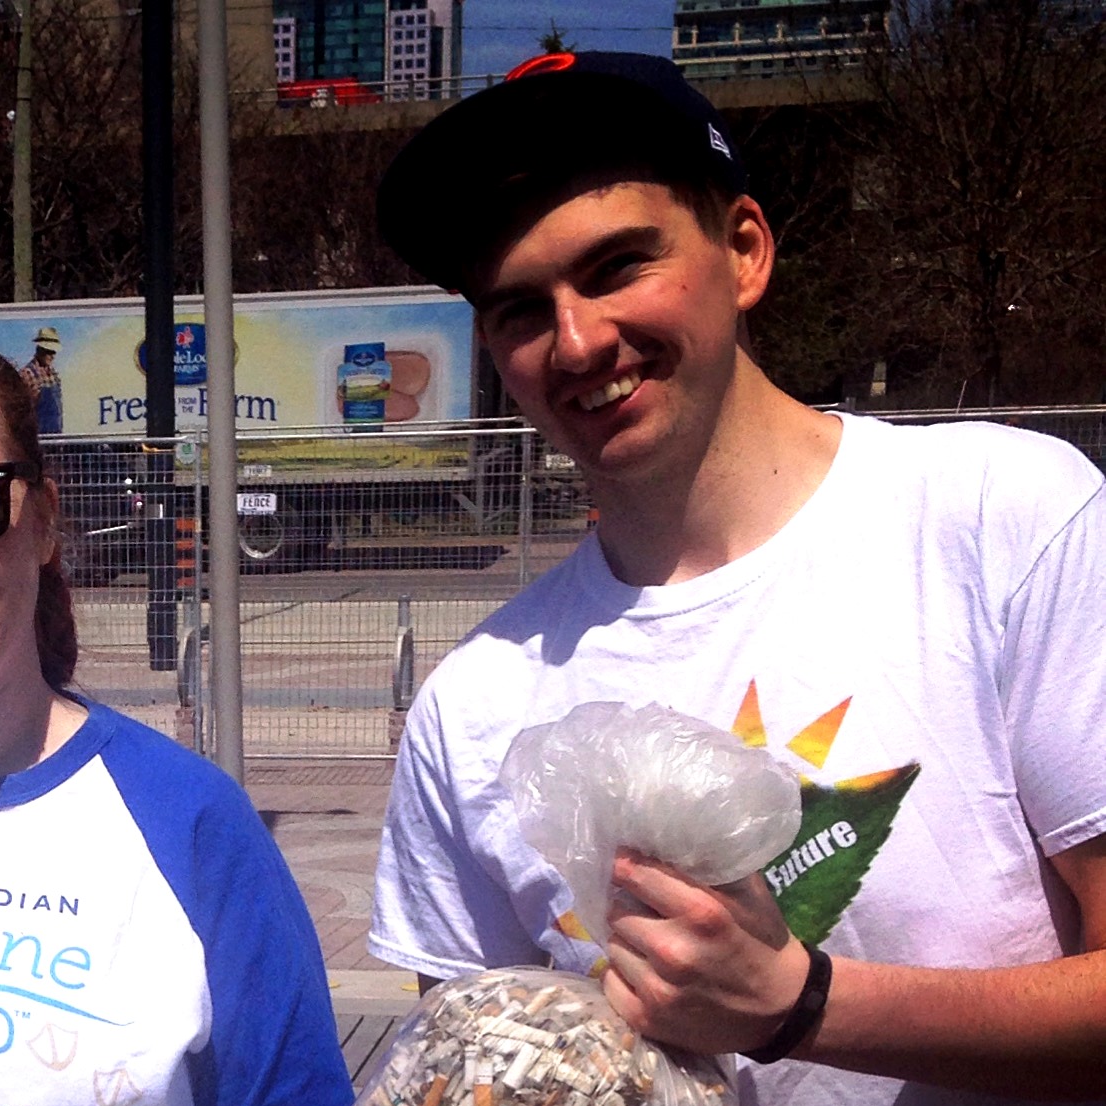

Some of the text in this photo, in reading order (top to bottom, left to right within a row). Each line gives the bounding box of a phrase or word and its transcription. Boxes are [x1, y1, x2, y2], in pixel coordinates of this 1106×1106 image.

[98, 395, 177, 425] Fre
[198, 388, 277, 421] Frm
[765, 820, 858, 896] Future
